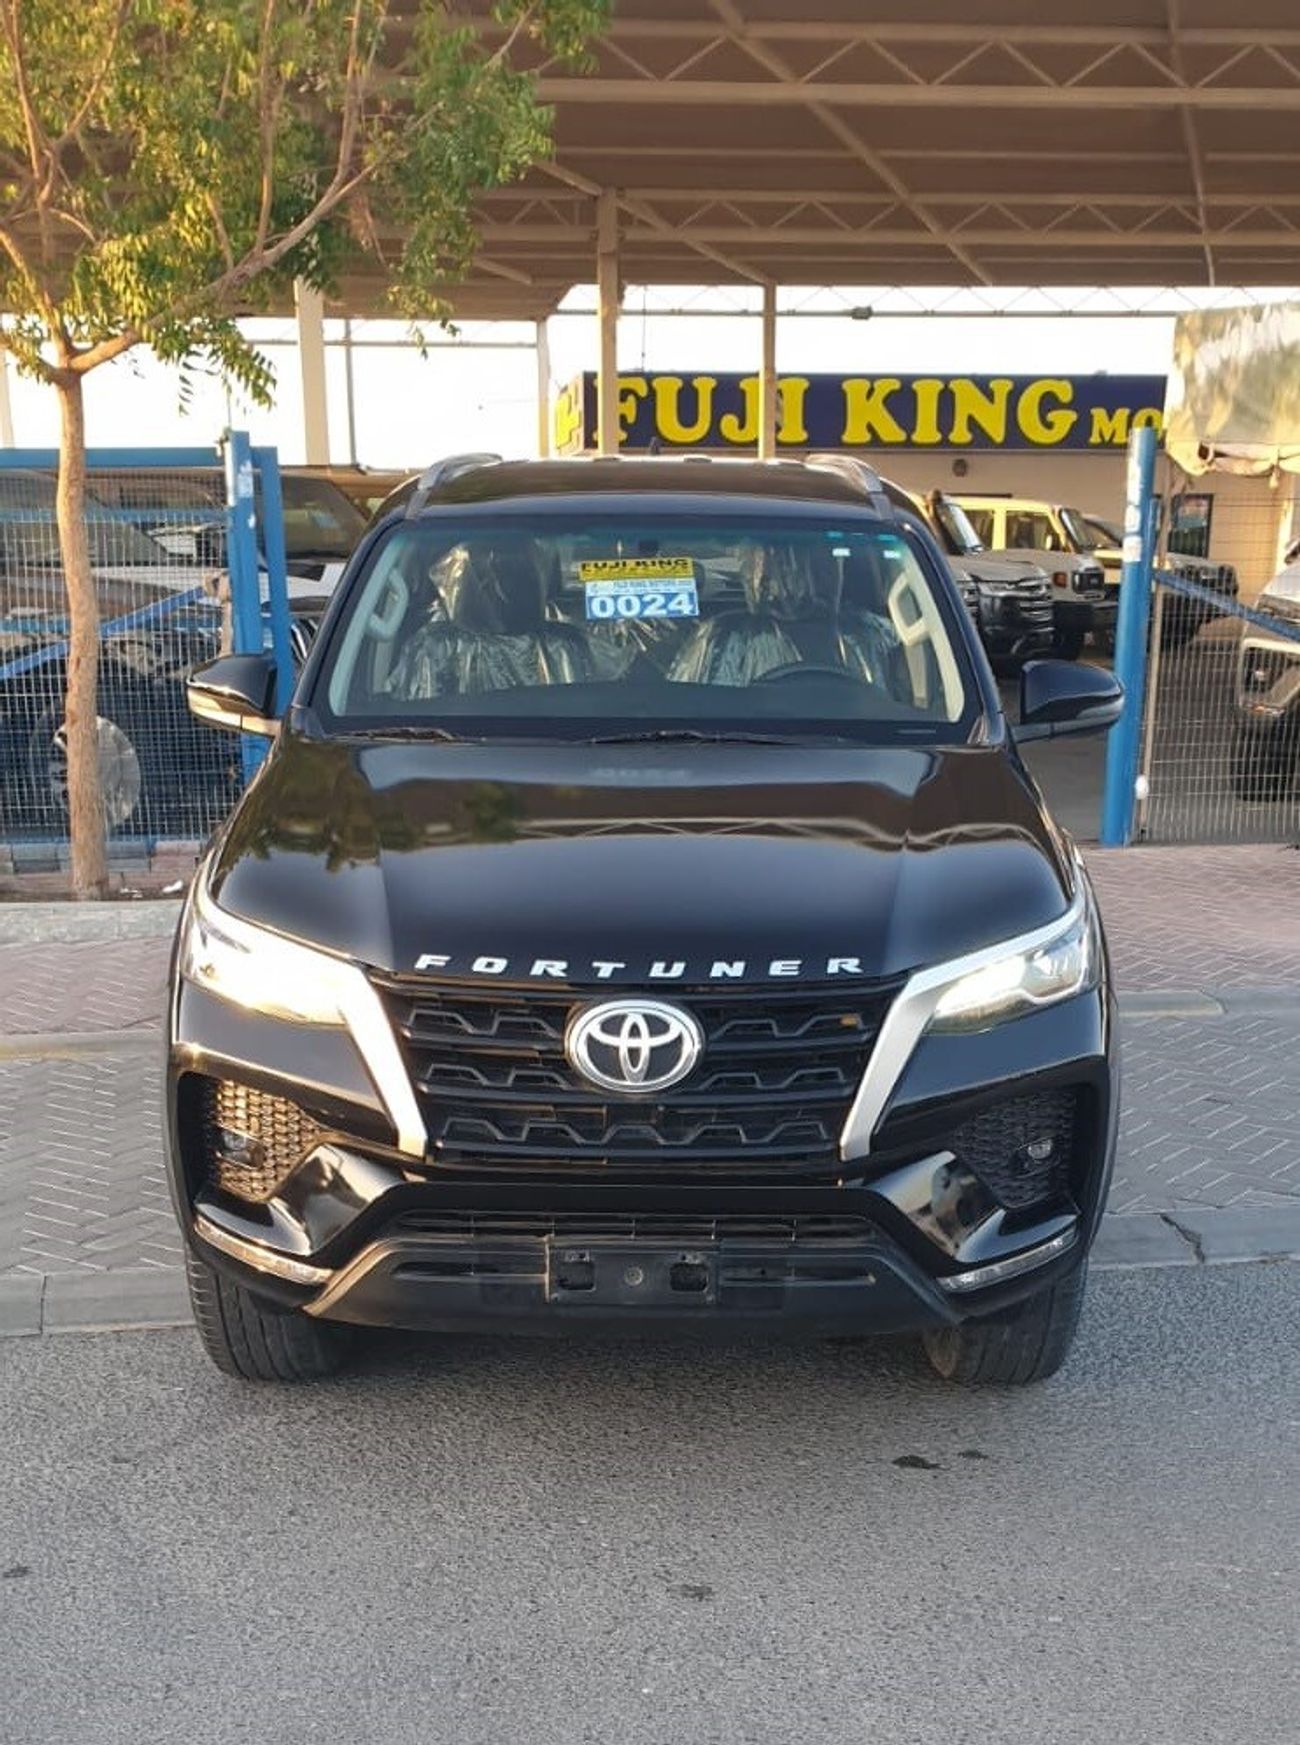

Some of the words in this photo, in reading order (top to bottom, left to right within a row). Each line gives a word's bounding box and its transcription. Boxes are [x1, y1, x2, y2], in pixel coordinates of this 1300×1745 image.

[593, 376, 809, 443] FUJI
[841, 378, 1077, 444] KING
[581, 561, 627, 571] FUJI
[635, 559, 689, 569] KING
[591, 592, 694, 618] 0024
[414, 954, 862, 978] FORTUNER
